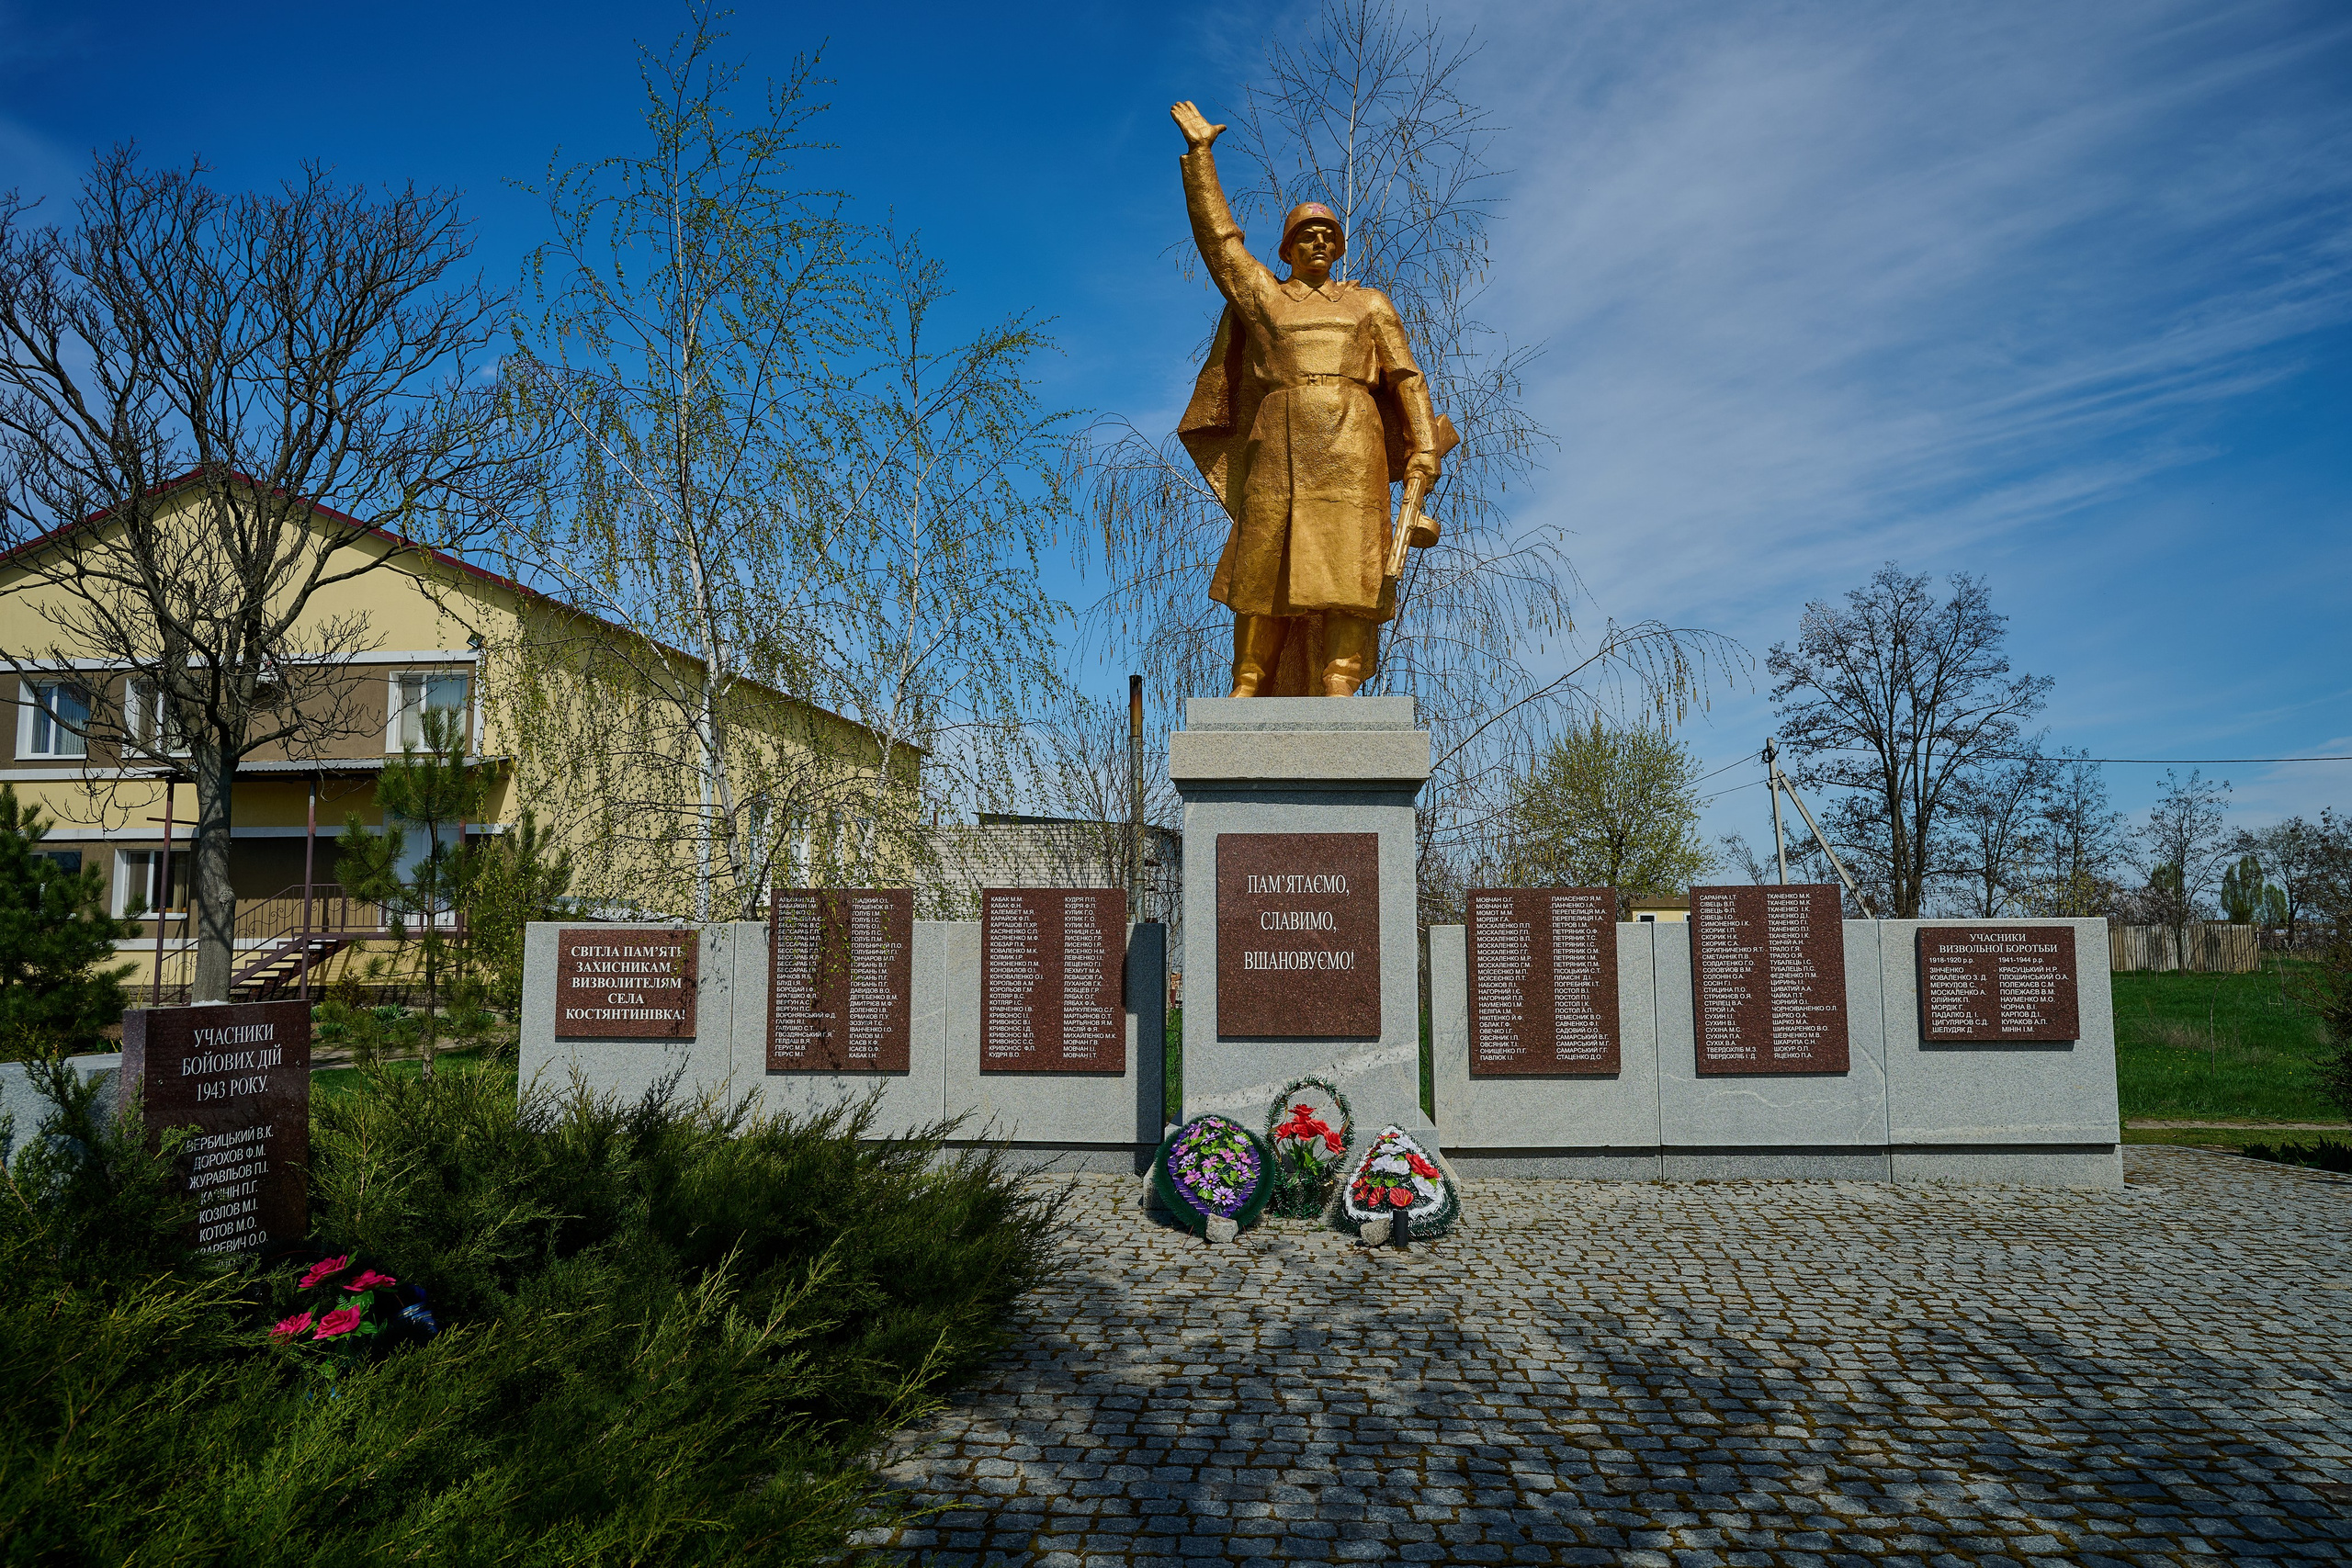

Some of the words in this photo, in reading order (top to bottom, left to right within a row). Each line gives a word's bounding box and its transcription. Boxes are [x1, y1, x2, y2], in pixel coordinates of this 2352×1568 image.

[1261, 911, 1338, 933] СЛАВИМО,
[1969, 933, 2027, 942] УЧАСНИКИ
[571, 946, 620, 957] СВІТЛА
[1939, 944, 2003, 953] ВИЗВОЛЬНОЇ
[2006, 944, 2058, 953] БОРОТЬБИ
[576, 961, 671, 973] ЗАХИСНИКАМ
[1244, 951, 1355, 970] ВШАНОВУЄМО!
[1998, 965, 2044, 974] КРАСУЦЬКИЙ
[1998, 973, 2054, 981] ПЛОШИНСЬКИЙ
[571, 977, 682, 988] ВИЗВОЛИТЕЛЯМ
[607, 993, 644, 1004] СЕЛА
[565, 1009, 685, 1020] КОСТЯНТИНІВКА!
[1931, 1019, 1974, 1027] ЦИГУЛЯРОВ
[1974, 1019, 1989, 1027] С.Д.
[193, 1023, 275, 1047] УЧАСНИКИ
[1555, 1026, 1586, 1034] САДОВИЙ
[182, 1050, 254, 1077] БОЙОВИХ
[257, 1043, 282, 1072] ДІЙ
[196, 1080, 225, 1102] 1943
[230, 1075, 268, 1097] РОКУ.
[186, 1125, 254, 1153] ВЕРБИЦЬКИЙ
[256, 1125, 274, 1140] В.К.
[193, 1147, 243, 1172] ДОРОХОВ
[245, 1144, 266, 1158] Ф.М.
[188, 1164, 253, 1190] ЖУРАВЛЬОВ
[254, 1160, 269, 1175] П.І.
[242, 1179, 258, 1196] П.Г.
[198, 1201, 240, 1224] КОЗЛОВ
[242, 1198, 259, 1213] М.І.
[199, 1222, 234, 1243] КОТОВ
[236, 1216, 257, 1233] М.О.
[248, 1230, 268, 1247] О.О.
